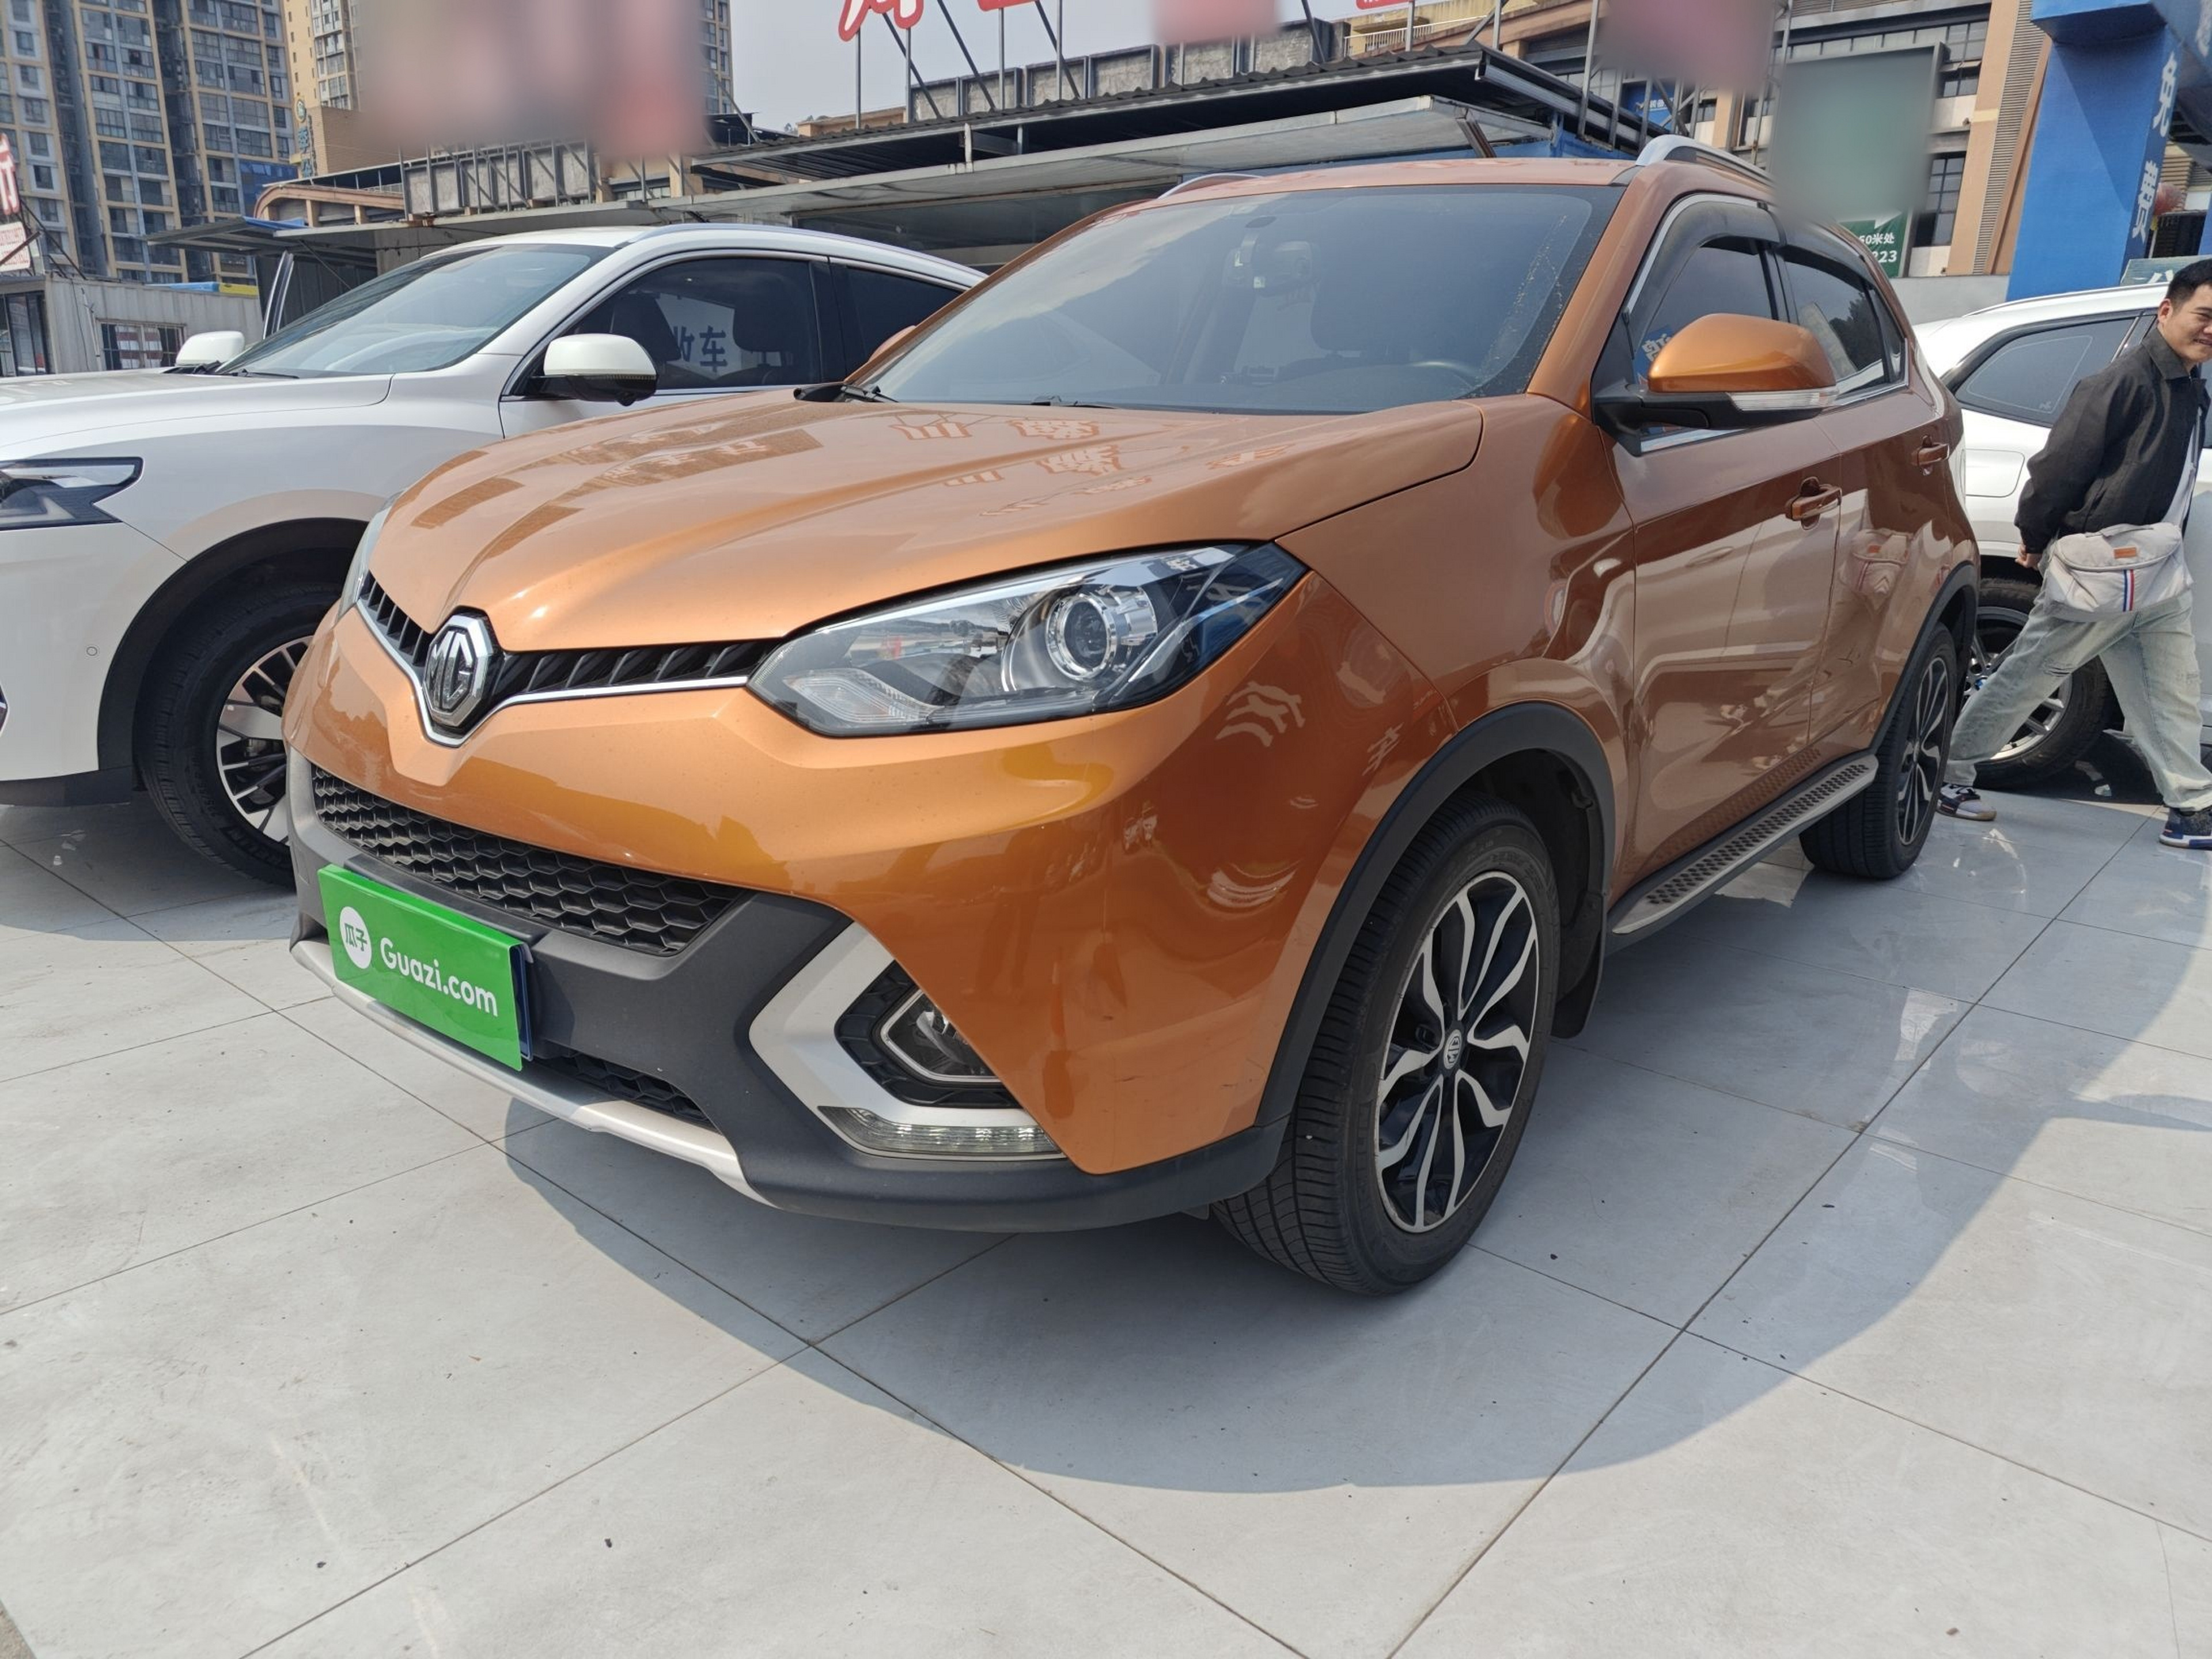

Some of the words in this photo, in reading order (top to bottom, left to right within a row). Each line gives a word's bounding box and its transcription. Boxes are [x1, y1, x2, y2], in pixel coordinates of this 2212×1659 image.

[2133, 51, 2177, 243] 免费
[344, 923, 368, 952] 瓜子
[380, 937, 498, 1017] Guazi.com
